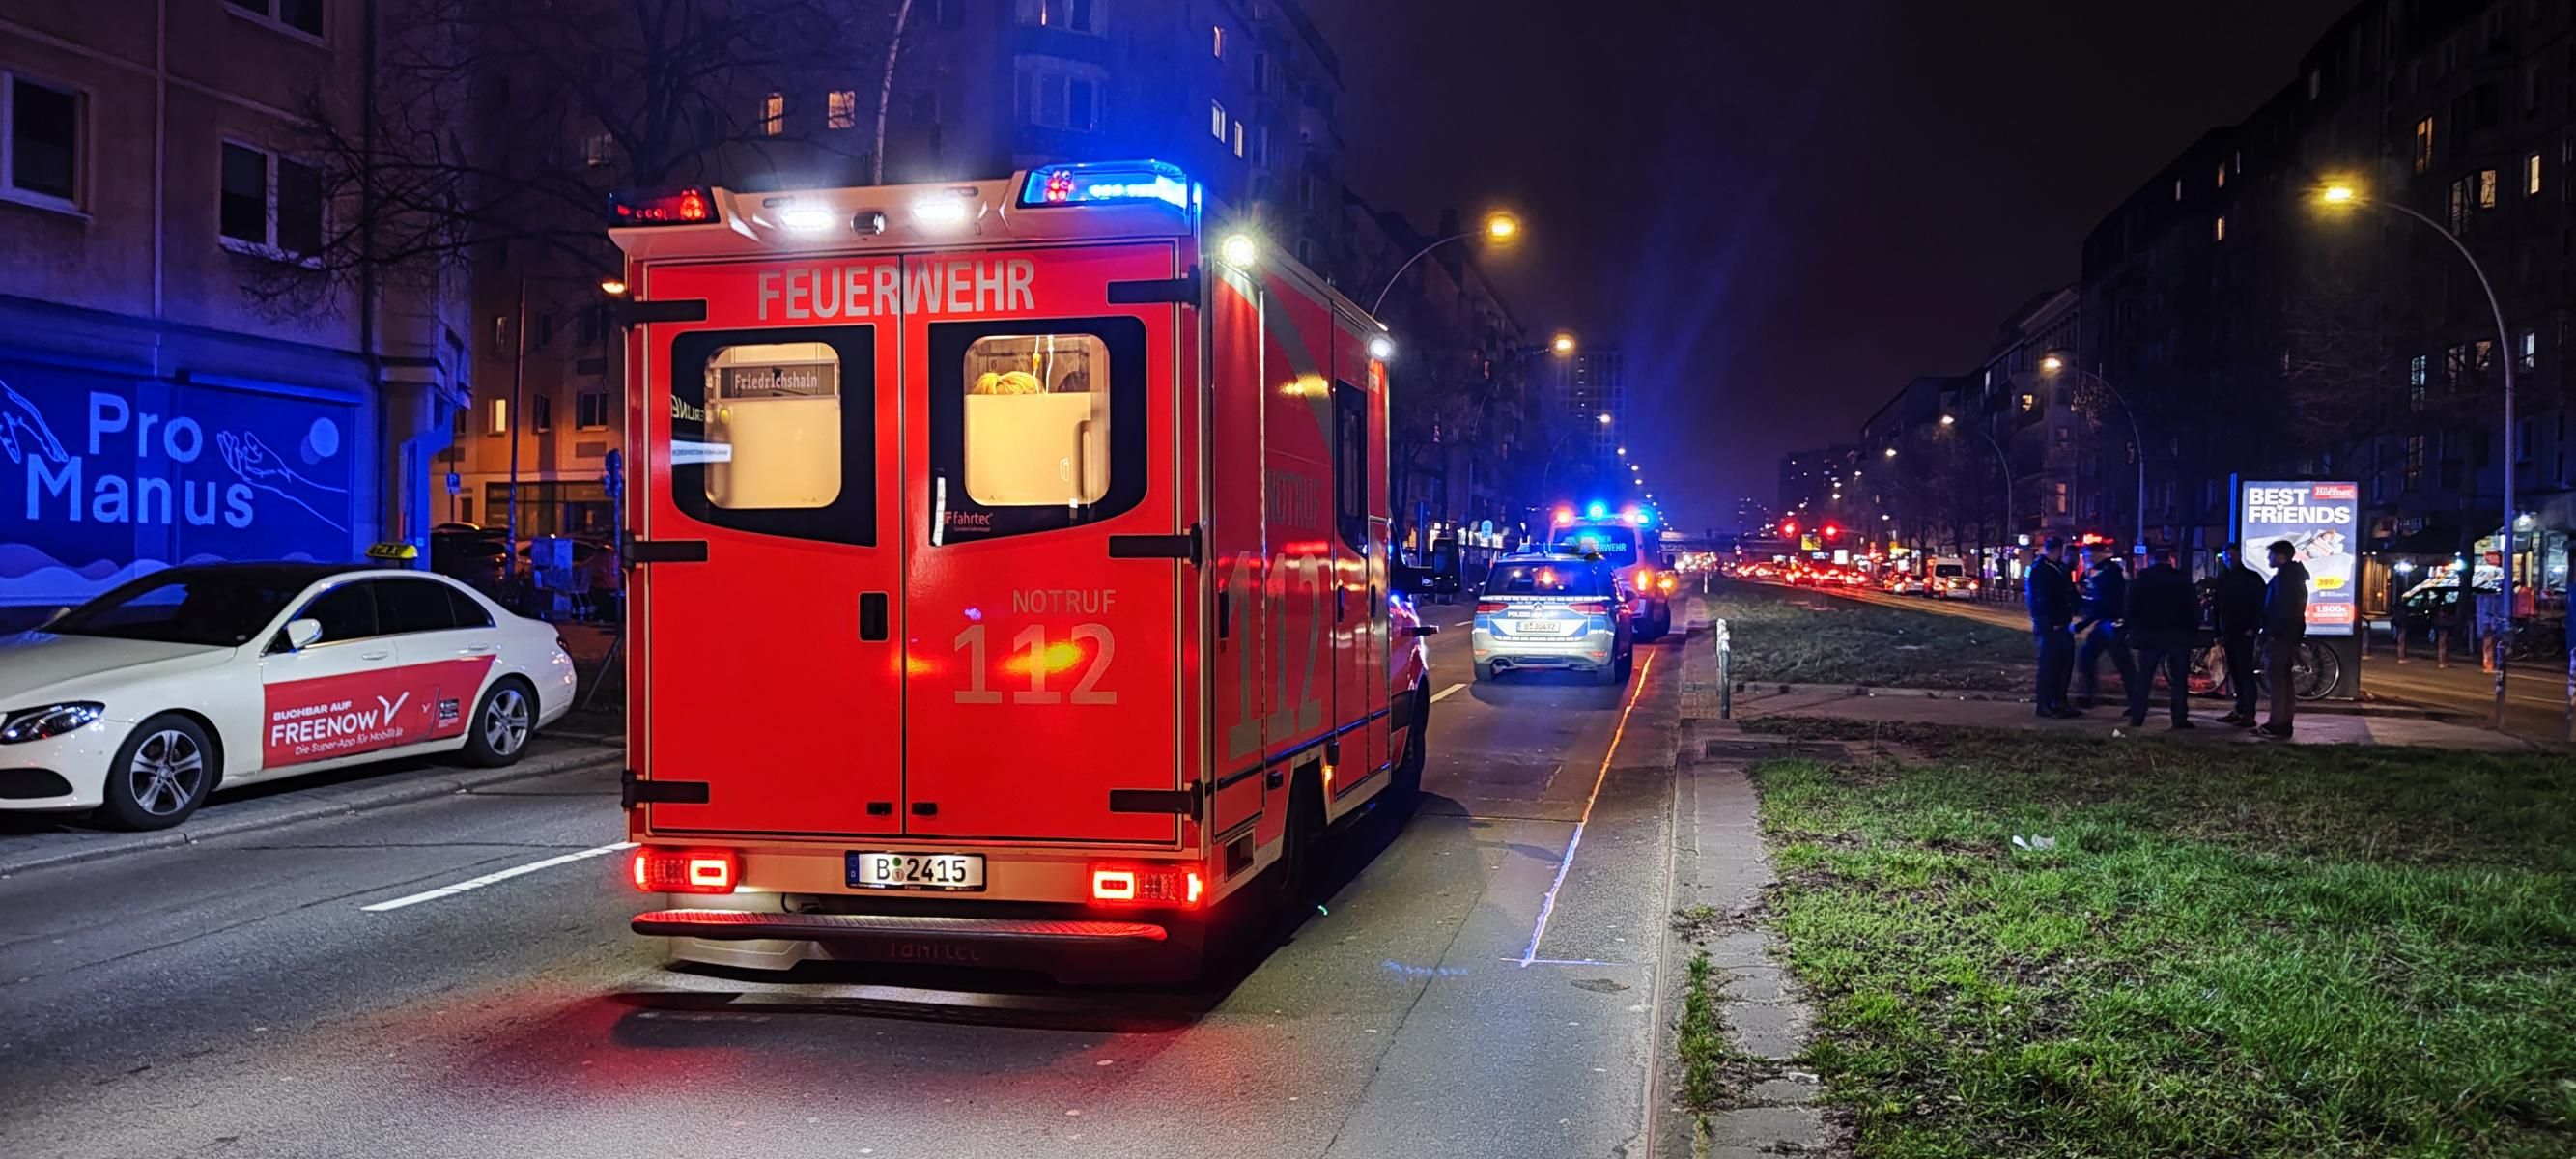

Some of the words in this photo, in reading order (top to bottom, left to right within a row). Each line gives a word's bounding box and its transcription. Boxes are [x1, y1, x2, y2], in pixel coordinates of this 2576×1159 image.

[758, 258, 1035, 320] FEUERWEHR
[735, 371, 817, 390] Friedrichshain
[89, 390, 204, 463] Pro
[26, 453, 254, 529] Manus
[448, 474, 458, 486] P
[1266, 468, 1320, 530] NOTRUF
[2249, 488, 2309, 505] BEST
[953, 511, 990, 525] fahrtec
[1580, 543, 1627, 552] FERWEHR
[1013, 589, 1117, 614] NOTRUF
[954, 623, 1118, 704] 112
[1229, 551, 1322, 761] 112
[273, 705, 328, 721] BUCHBAR
[330, 700, 353, 713] AUF
[271, 709, 378, 747] FREENOW
[296, 744, 309, 756] Die
[311, 737, 356, 752] Super-App
[357, 733, 369, 745] für
[370, 727, 404, 742] Mobilität
[876, 858, 891, 880] B
[906, 858, 967, 883] 2415
